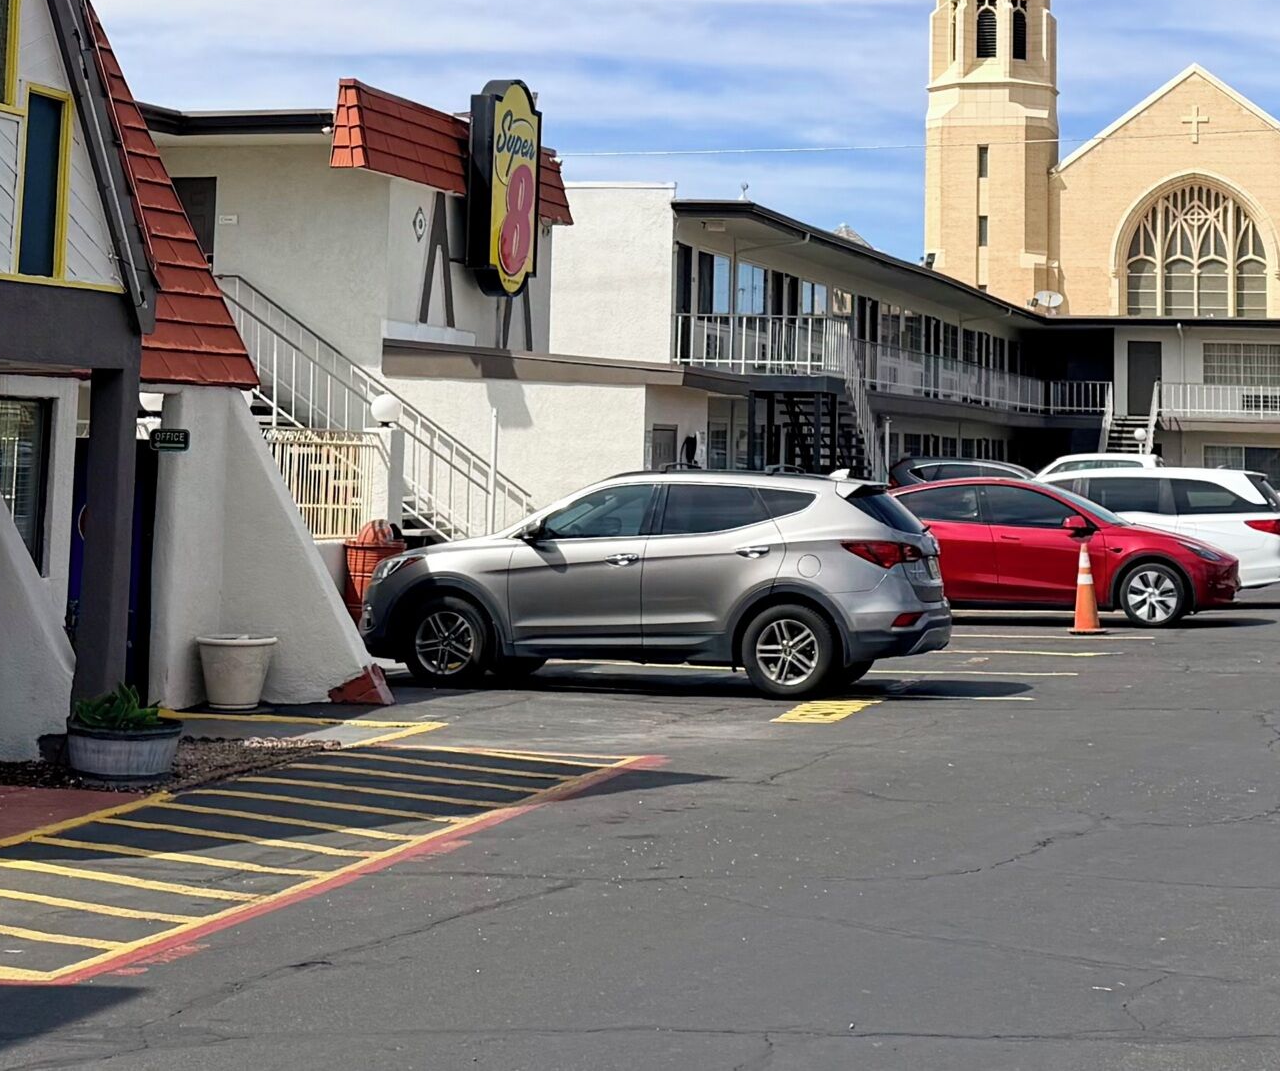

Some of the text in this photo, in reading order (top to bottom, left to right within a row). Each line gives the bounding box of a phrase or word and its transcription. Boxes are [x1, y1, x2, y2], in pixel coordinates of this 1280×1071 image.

[495, 109, 536, 178] Super
[499, 163, 535, 276] 8
[154, 431, 186, 442] OFFICE
